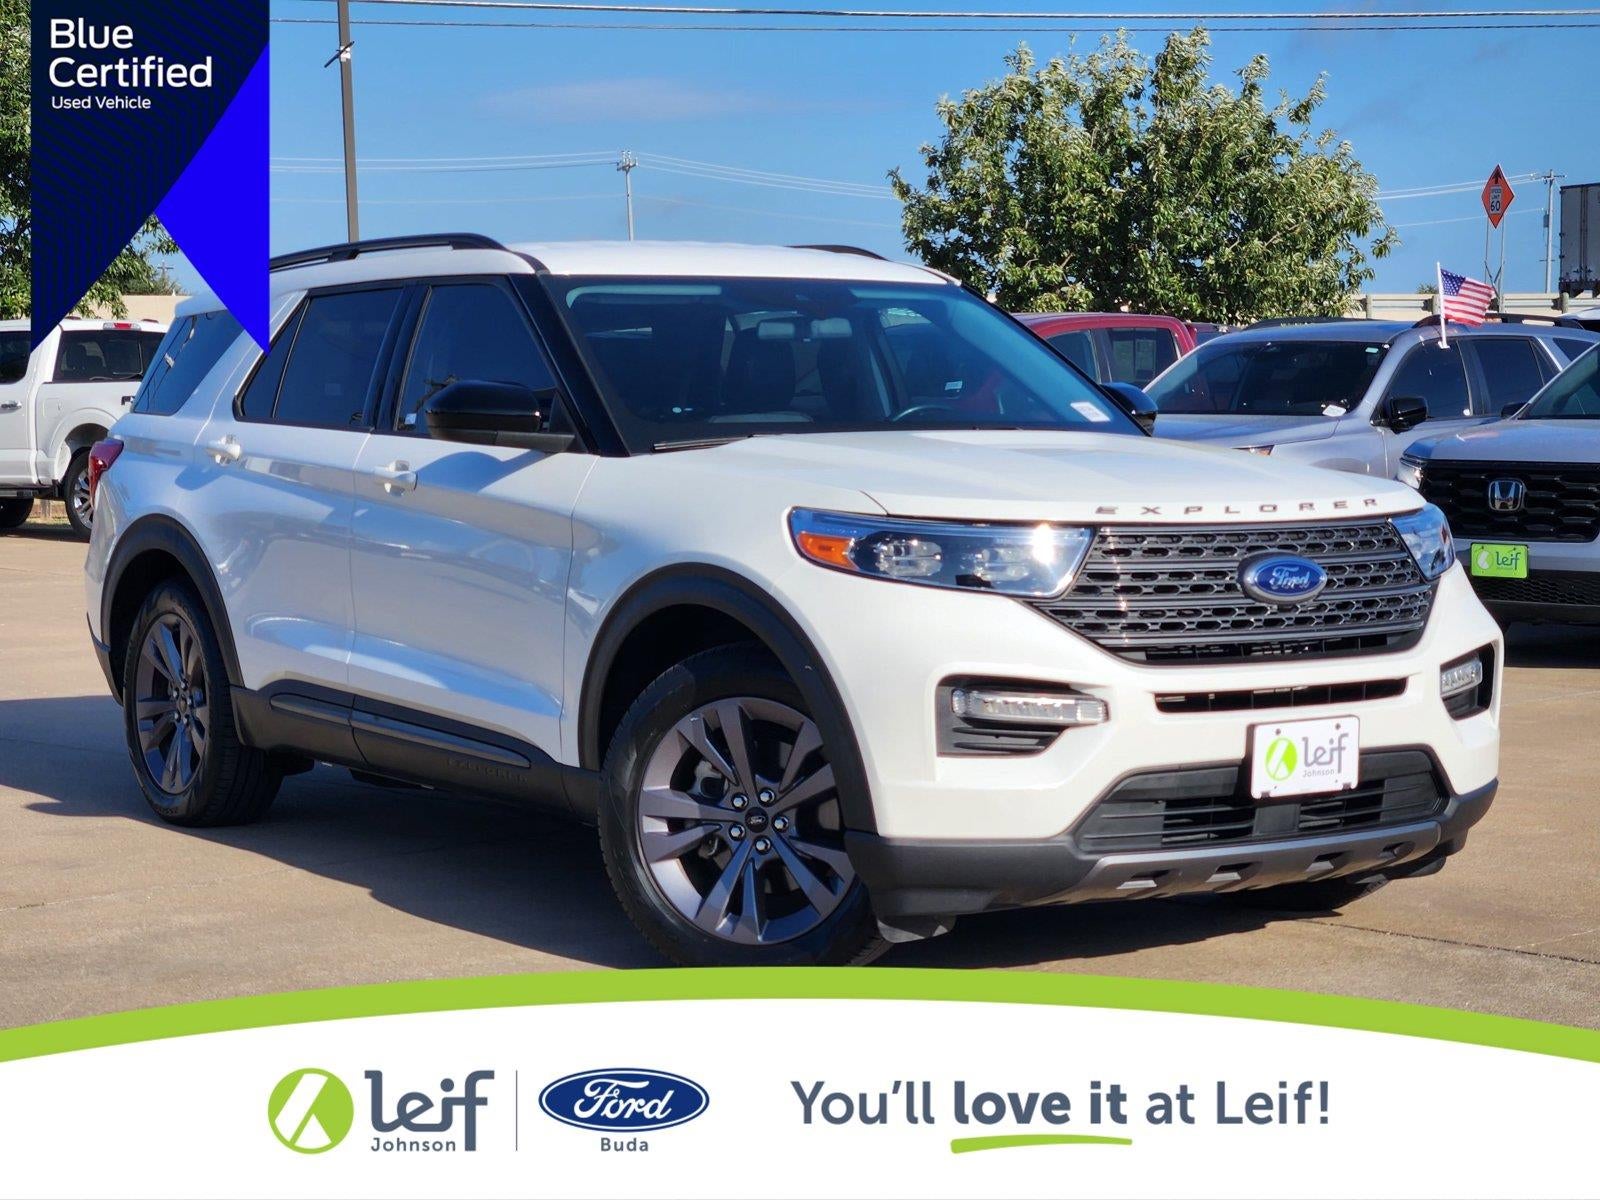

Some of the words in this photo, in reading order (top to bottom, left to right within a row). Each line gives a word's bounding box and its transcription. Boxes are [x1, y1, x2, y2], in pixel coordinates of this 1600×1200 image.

[1490, 200, 1501, 212] 60
[1095, 498, 1379, 515] EXPLORER
[1268, 565, 1312, 591] Ford
[1302, 769, 1335, 778] Johnson
